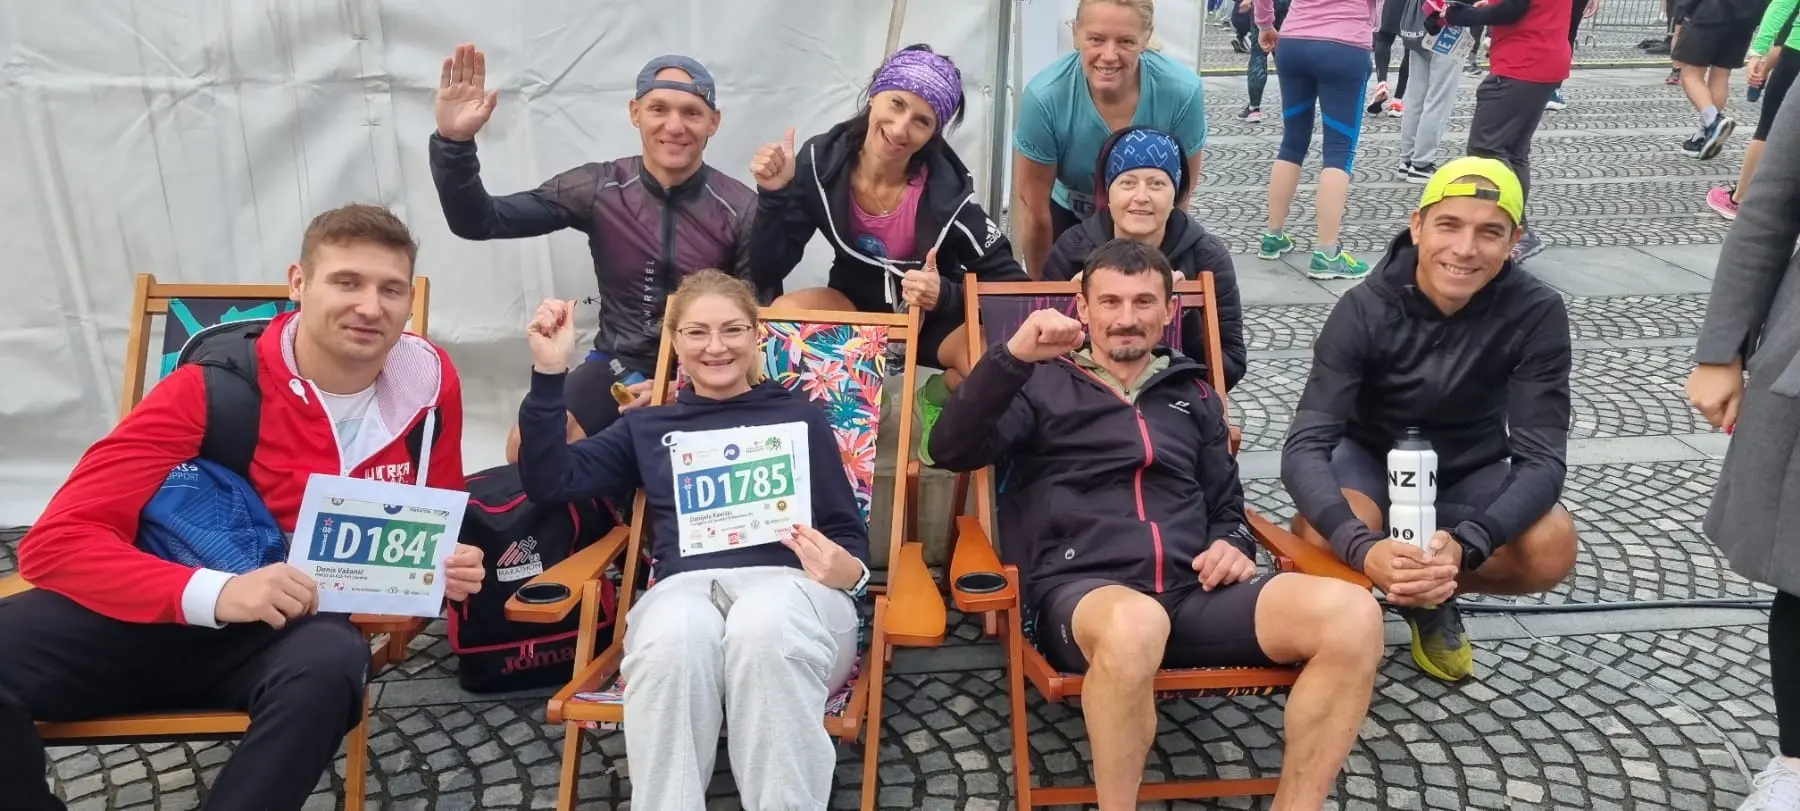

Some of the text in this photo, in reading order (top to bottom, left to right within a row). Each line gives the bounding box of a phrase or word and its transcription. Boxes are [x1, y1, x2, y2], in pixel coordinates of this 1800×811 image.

[695, 462, 787, 508] D1785
[334, 521, 441, 568] D1841
[498, 562, 542, 577] MARATHON
